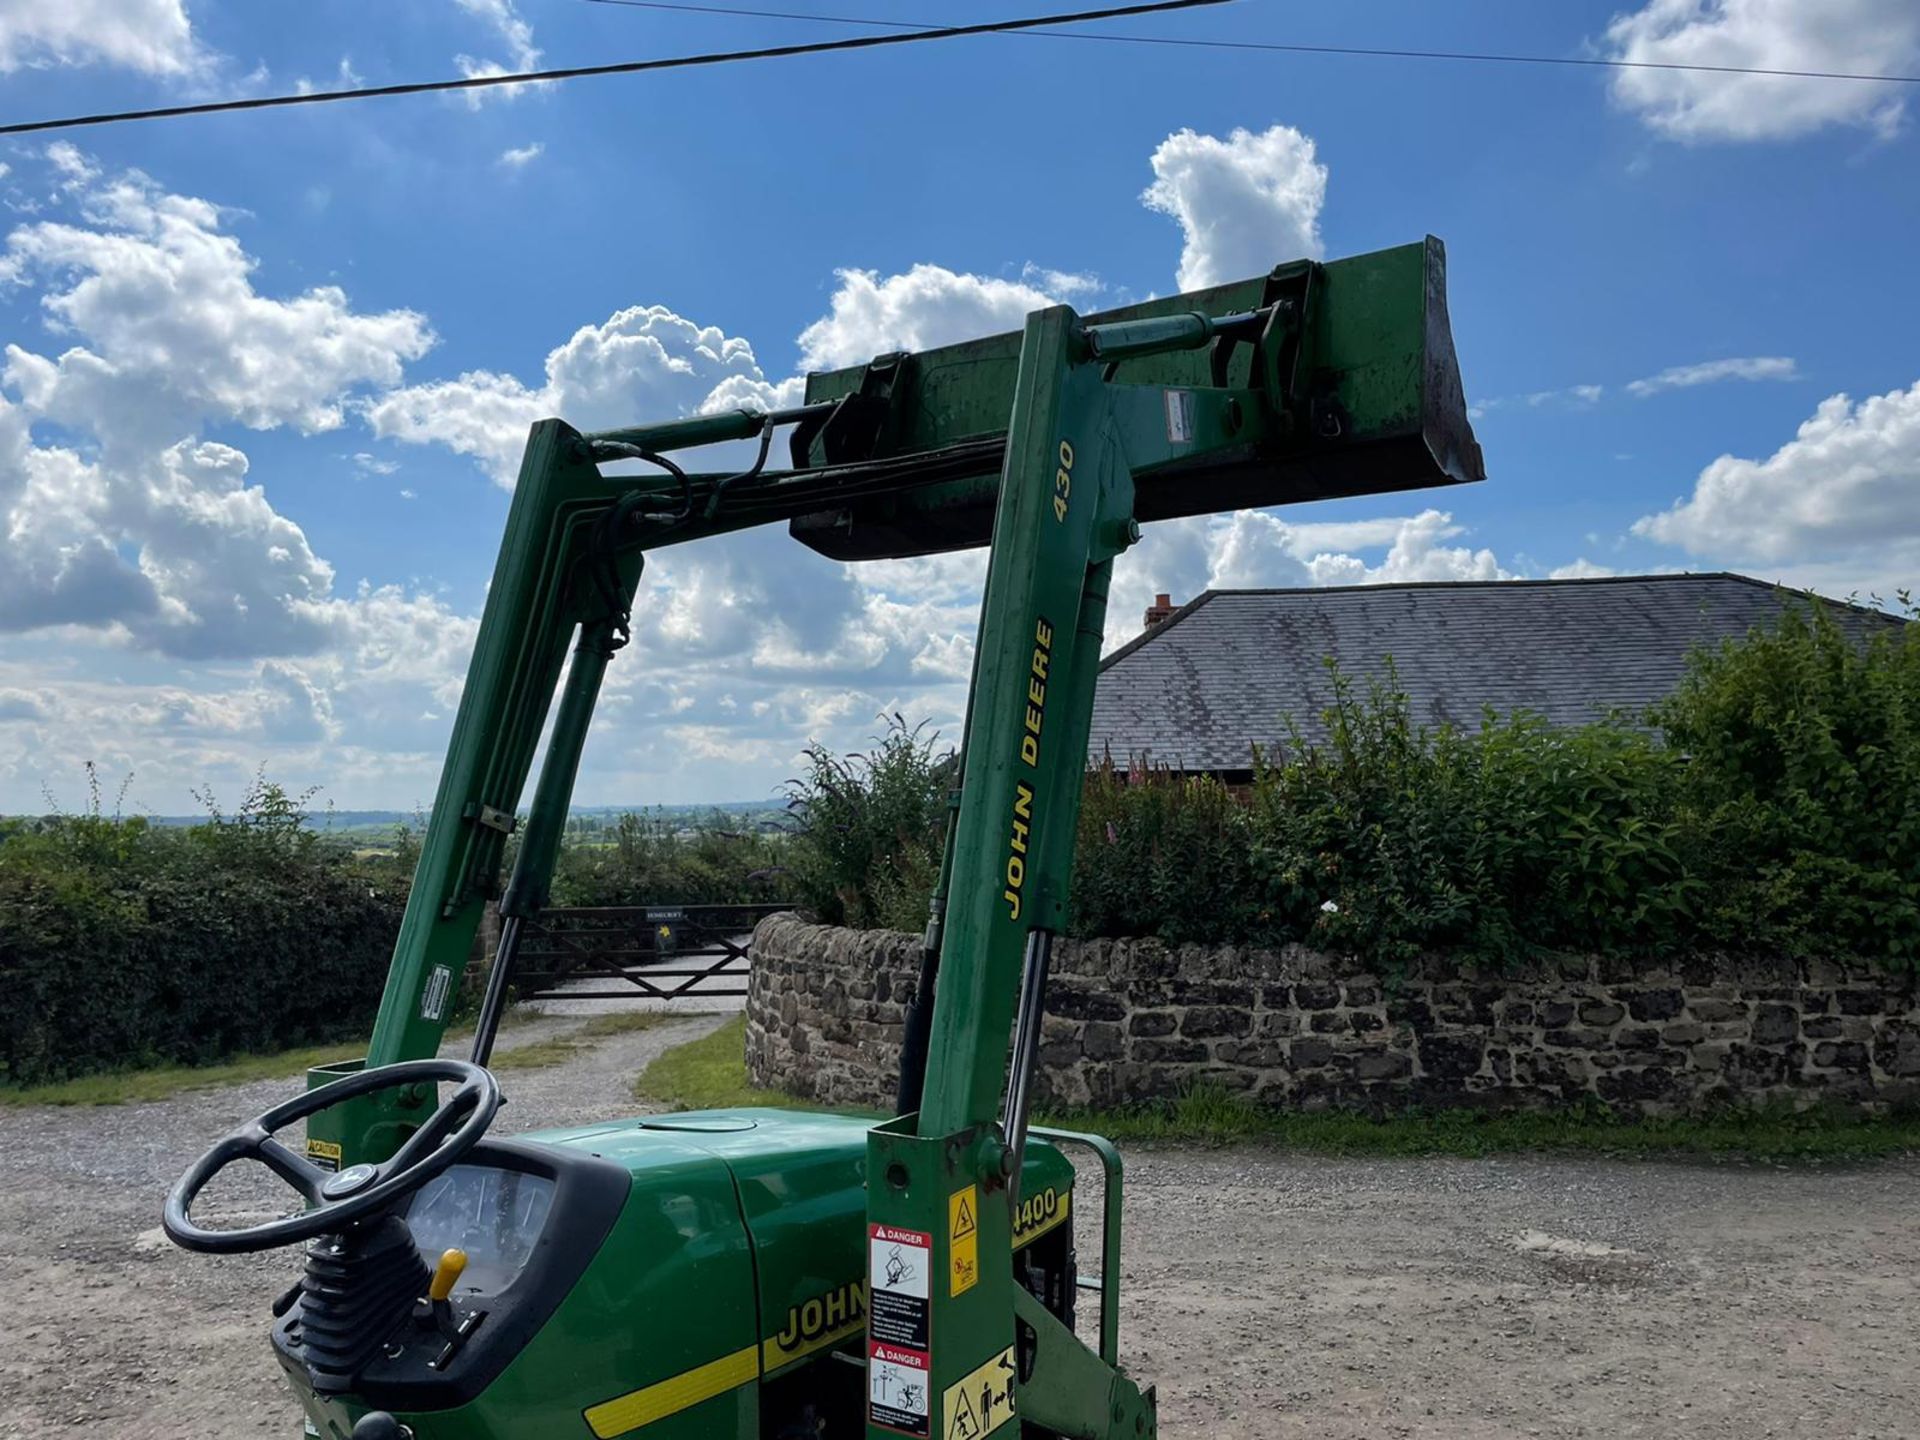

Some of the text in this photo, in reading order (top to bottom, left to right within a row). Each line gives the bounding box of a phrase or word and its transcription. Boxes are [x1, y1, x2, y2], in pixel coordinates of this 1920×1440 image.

[1053, 440, 1074, 523] 430
[1003, 619, 1053, 920] JOHN DEERE
[887, 1229, 923, 1245] DANGER
[778, 1279, 868, 1348] JOHN
[886, 1350, 922, 1367] DANGER
